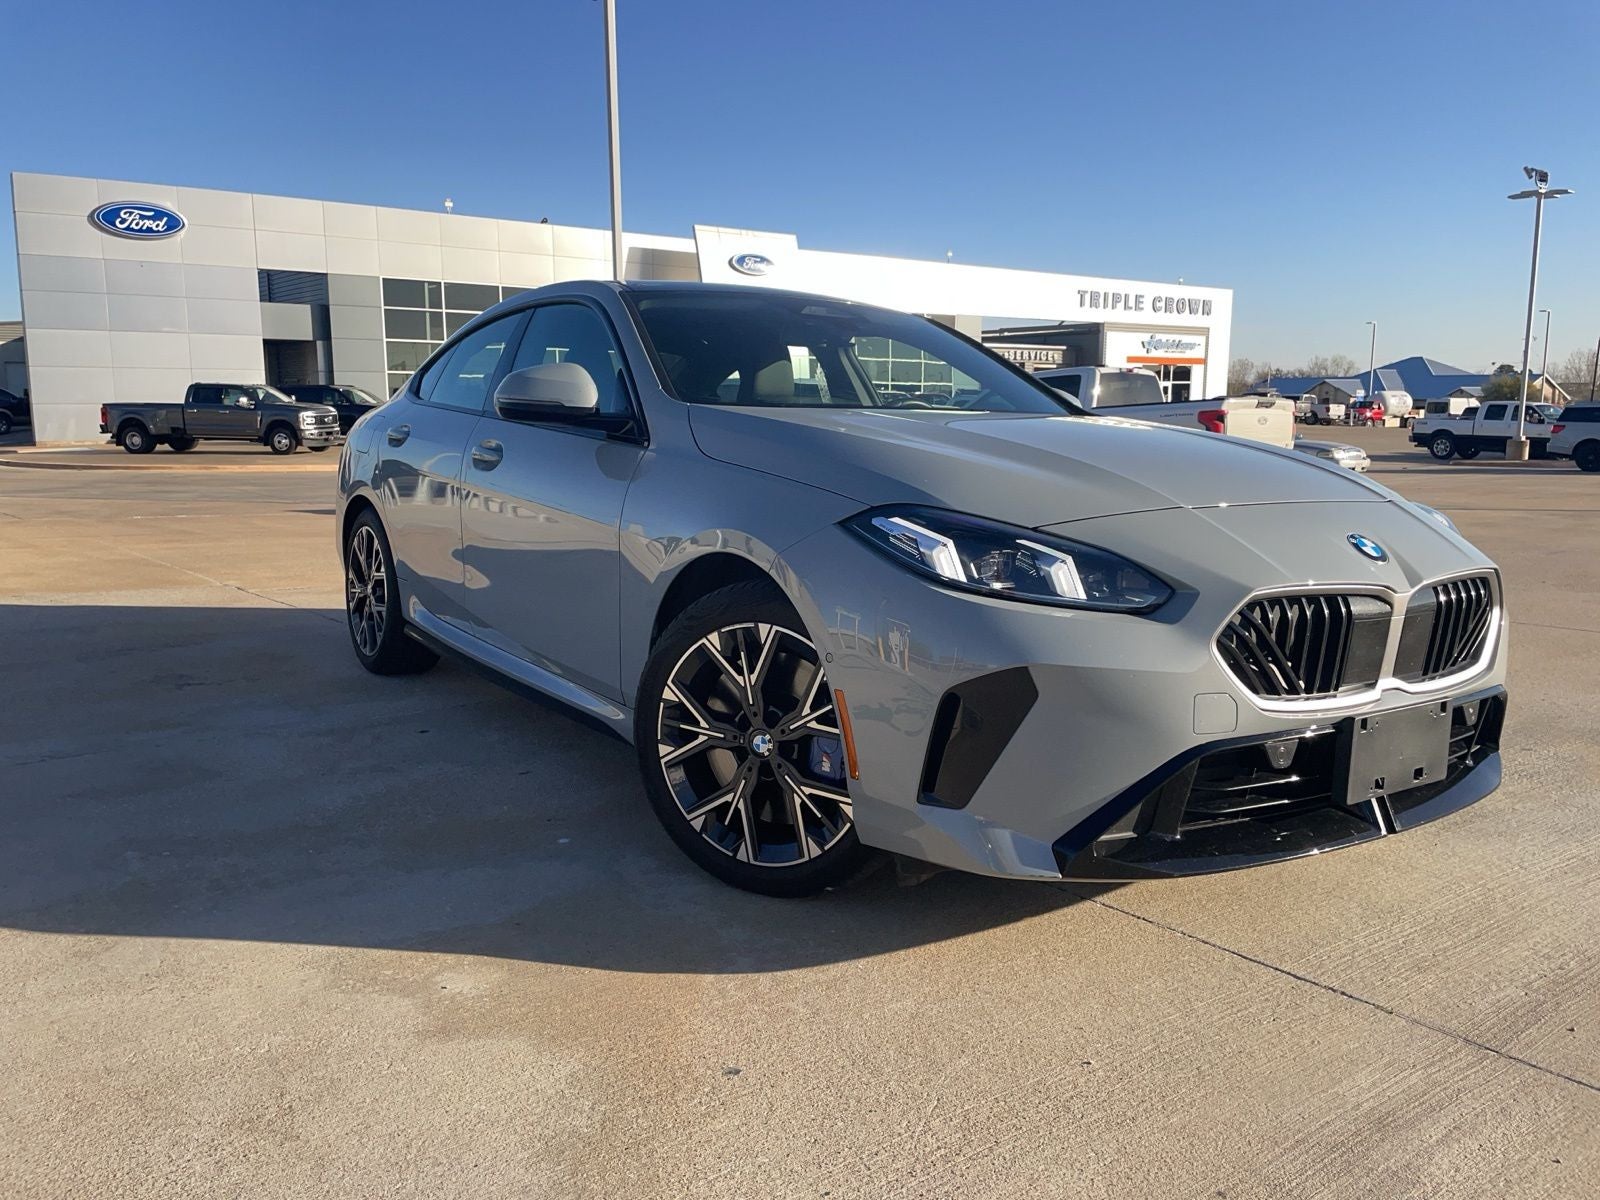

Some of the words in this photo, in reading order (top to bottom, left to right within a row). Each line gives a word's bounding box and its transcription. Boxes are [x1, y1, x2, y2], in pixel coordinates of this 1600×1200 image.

[115, 208, 168, 232] Ford
[1077, 289, 1145, 312] TRIPLE
[1152, 295, 1213, 316] CROWN
[1008, 350, 1054, 361] SERVICE
